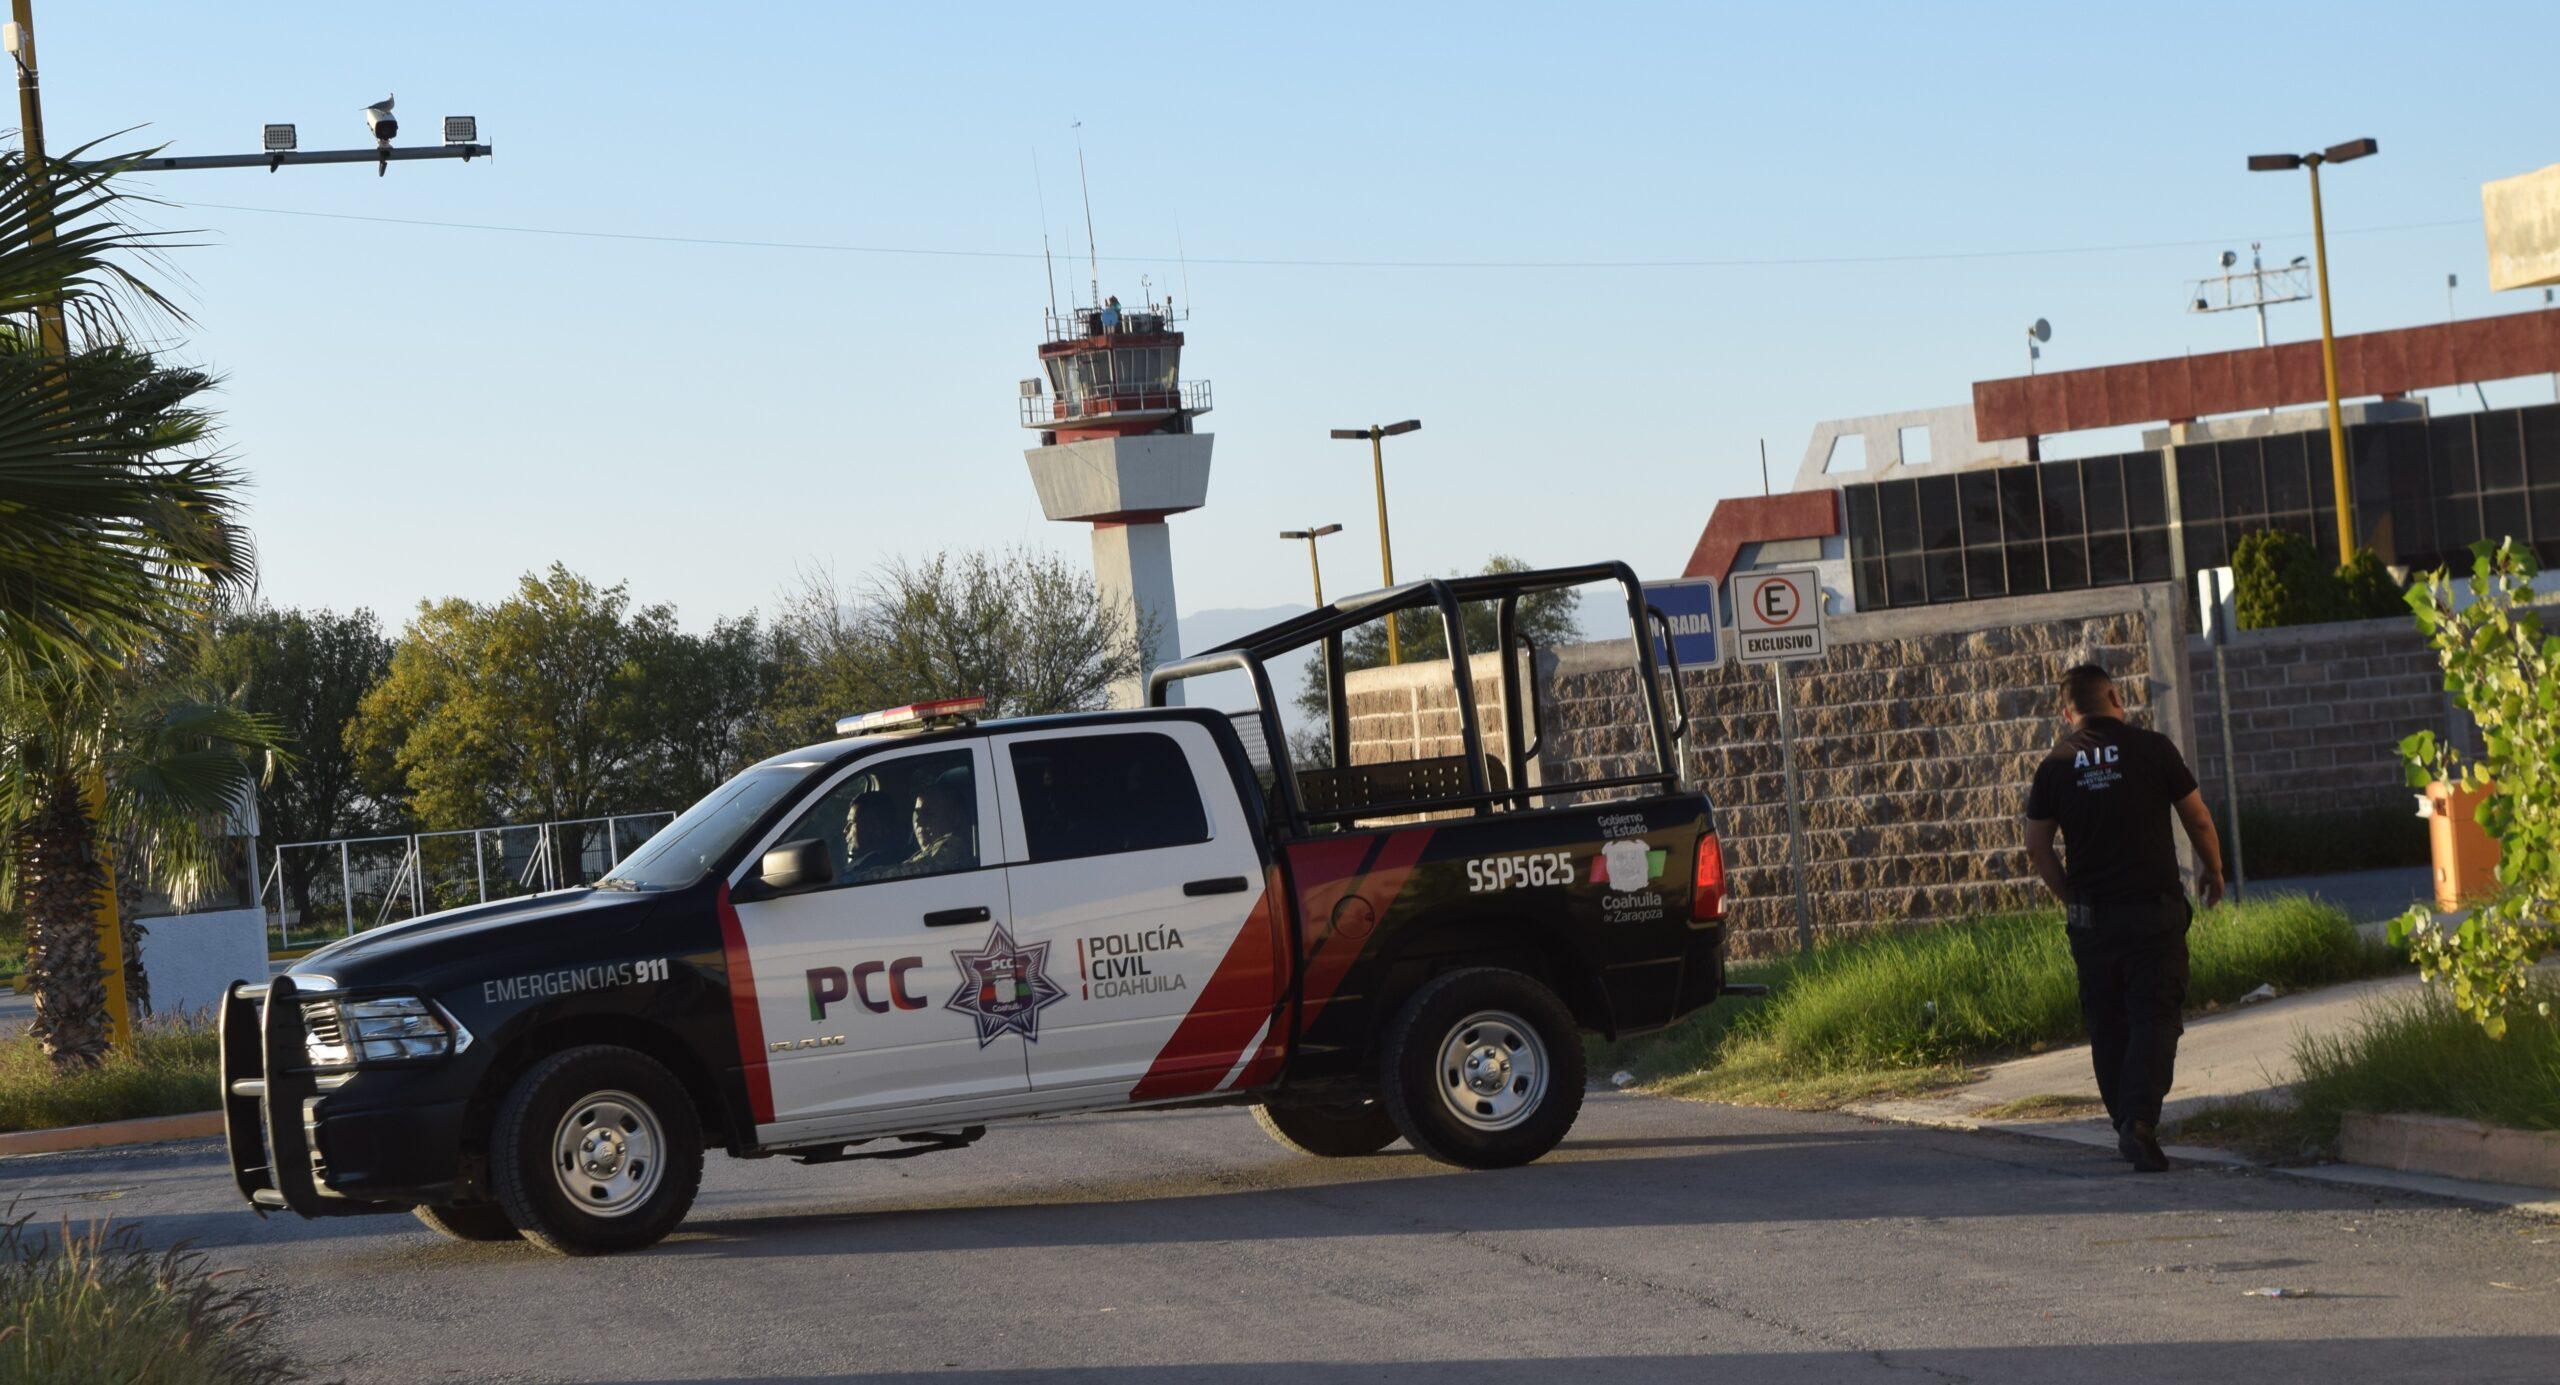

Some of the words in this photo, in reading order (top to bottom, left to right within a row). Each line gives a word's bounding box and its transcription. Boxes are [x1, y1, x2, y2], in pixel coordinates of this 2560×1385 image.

[1765, 585, 1788, 616] E
[1648, 613, 1711, 637] NRADA
[1748, 634, 1813, 653] EXCLUSIVO
[2074, 745, 2119, 769] AIC
[1597, 813, 1644, 827] Gobierno
[1613, 824, 1648, 837] Estado
[1466, 852, 1576, 892] SSP5625
[1602, 893, 1662, 910] Coahuila
[1614, 909, 1663, 923] Zaragoza
[1089, 924, 1184, 958] POLICÍA
[991, 958, 1014, 971] PCC
[1092, 956, 1151, 980] CIVIL
[484, 963, 633, 1003] EMERGENCIAS
[635, 957, 669, 984] 911
[806, 956, 928, 1021] PCC
[1094, 974, 1187, 1000] COAHUILA
[769, 1035, 845, 1052] RAM
